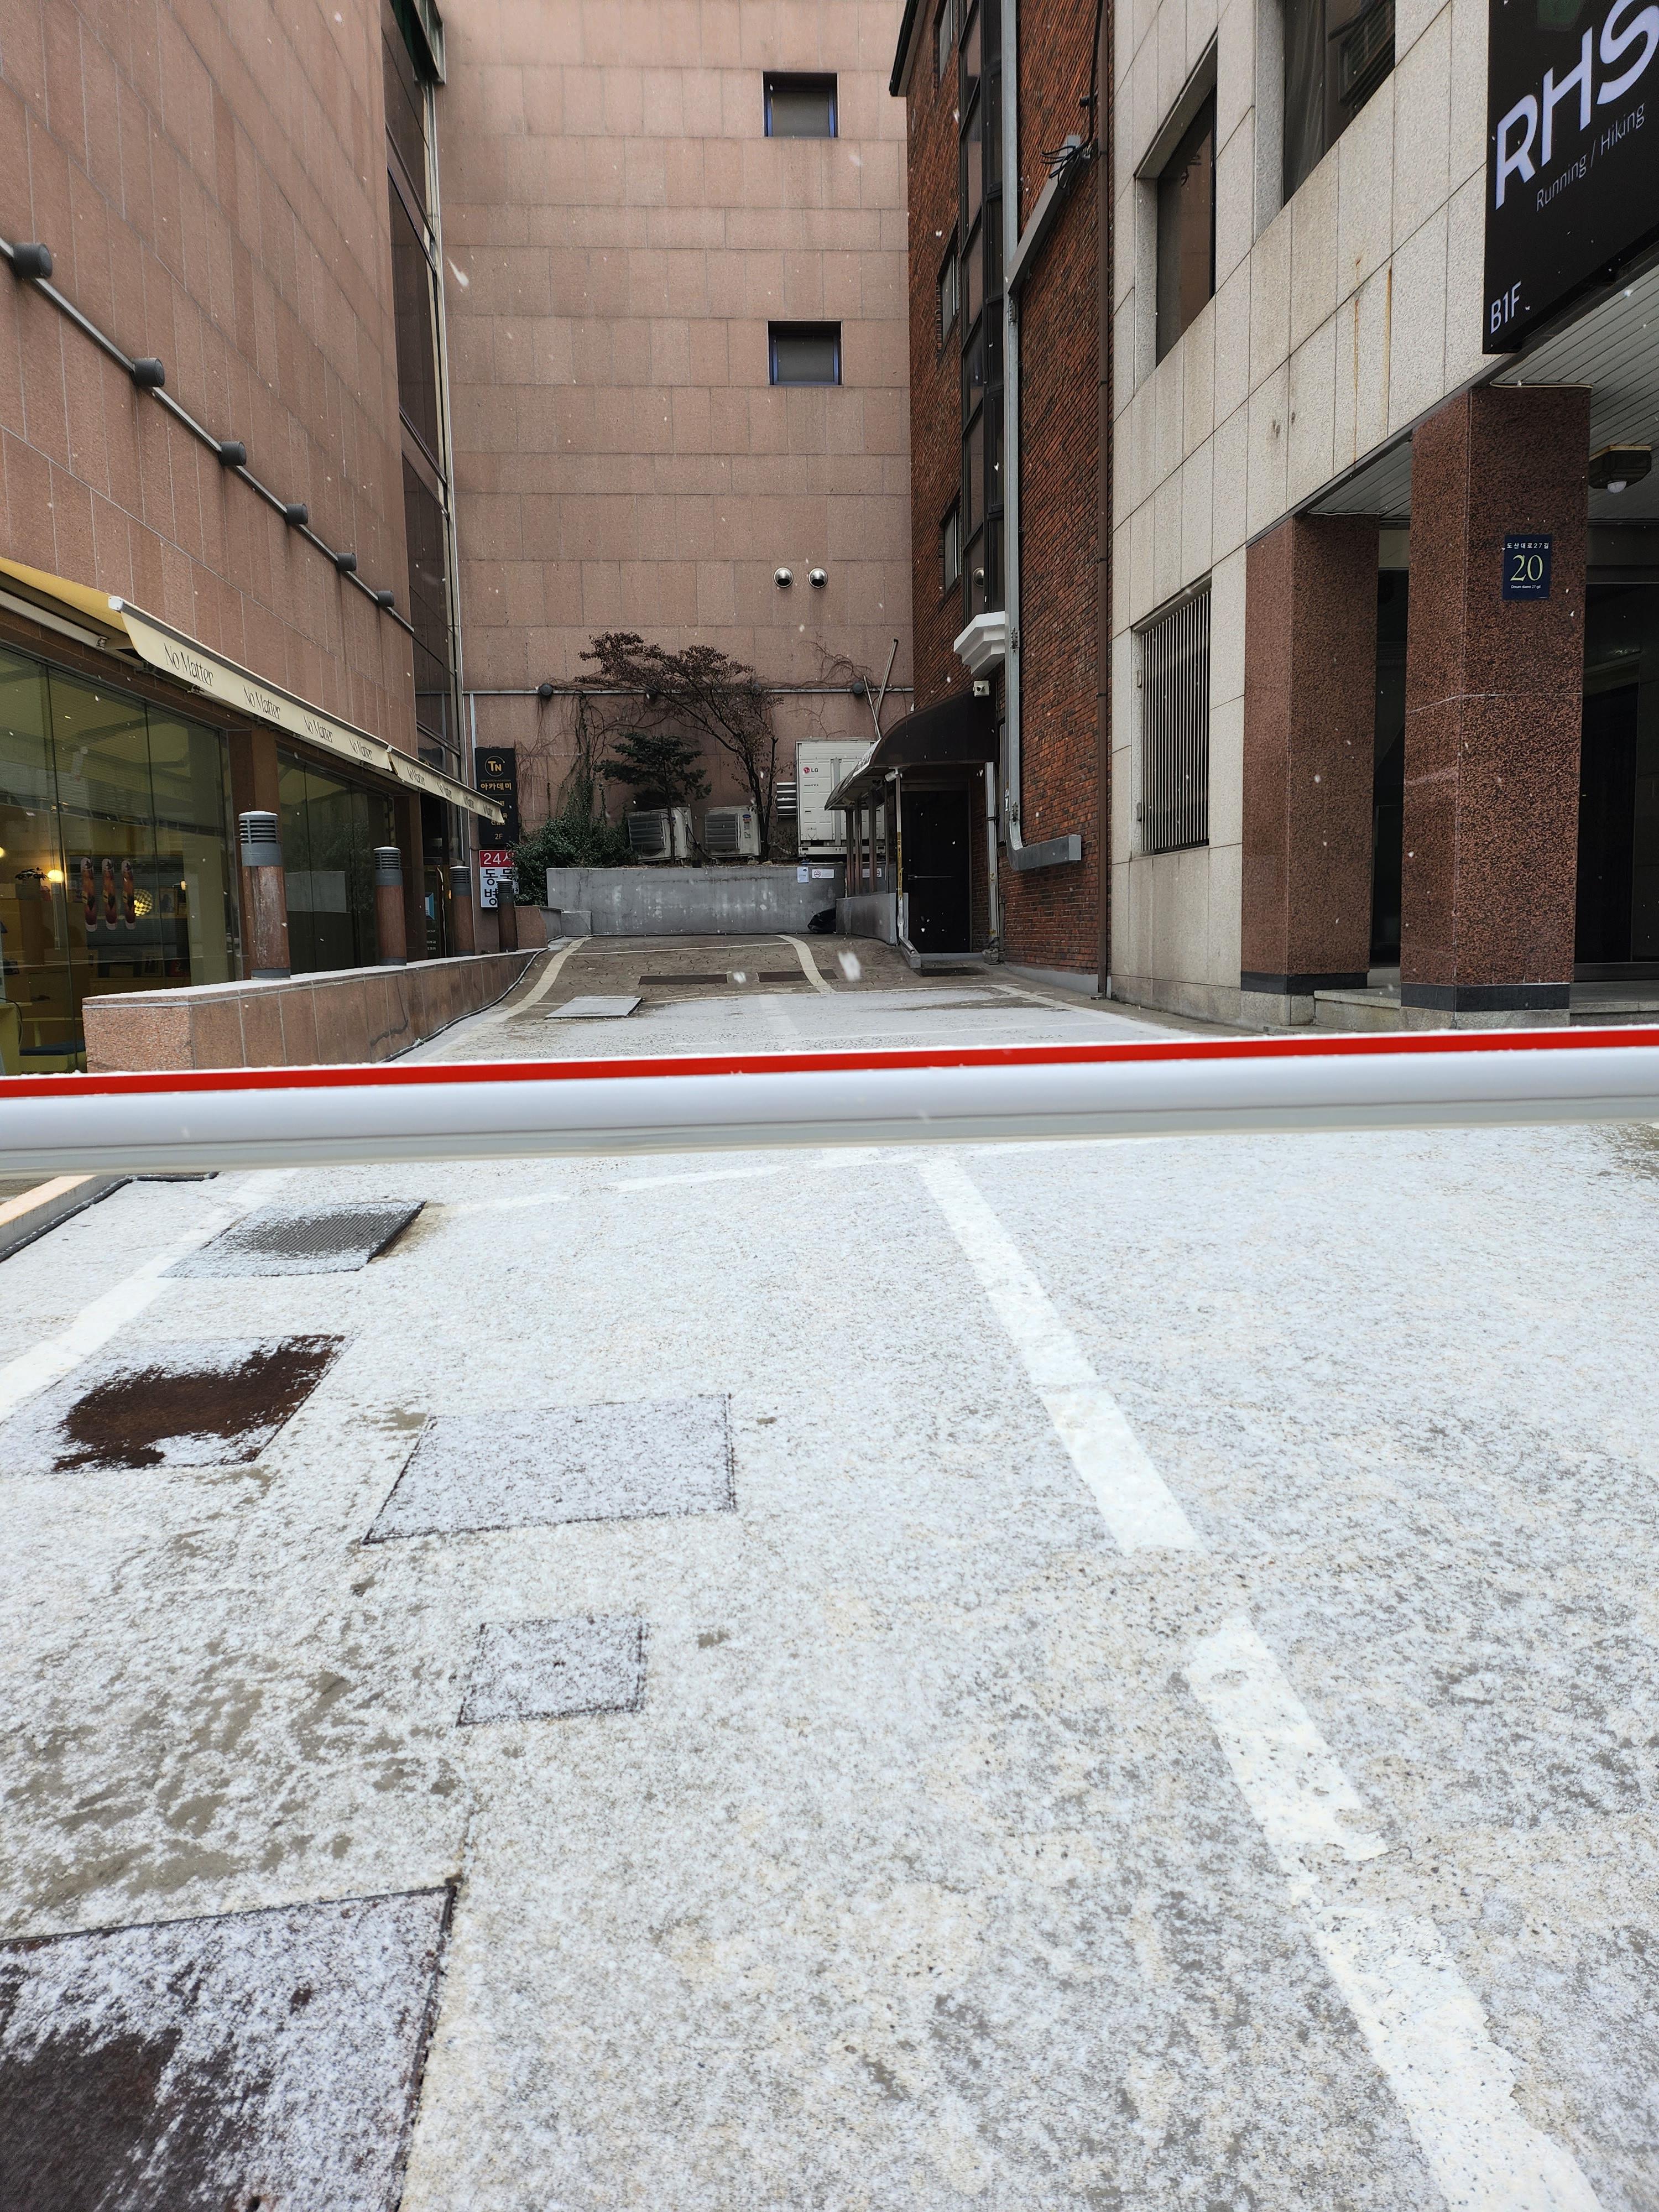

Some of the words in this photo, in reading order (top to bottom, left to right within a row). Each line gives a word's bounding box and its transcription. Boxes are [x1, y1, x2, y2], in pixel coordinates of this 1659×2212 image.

[1496, 0, 1659, 210] RHS
[1537, 153, 1587, 212] Running
[1601, 103, 1645, 155] Hiking
[1491, 280, 1521, 334] B1F
[1510, 555, 1543, 582] 20
[164, 643, 180, 670] No
[179, 651, 213, 686] Matter
[243, 685, 255, 708] No
[255, 692, 281, 719] Matter
[304, 715, 314, 734] No
[313, 719, 333, 743] Matter
[488, 761, 502, 771] TN
[481, 782, 512, 791] 아카데미
